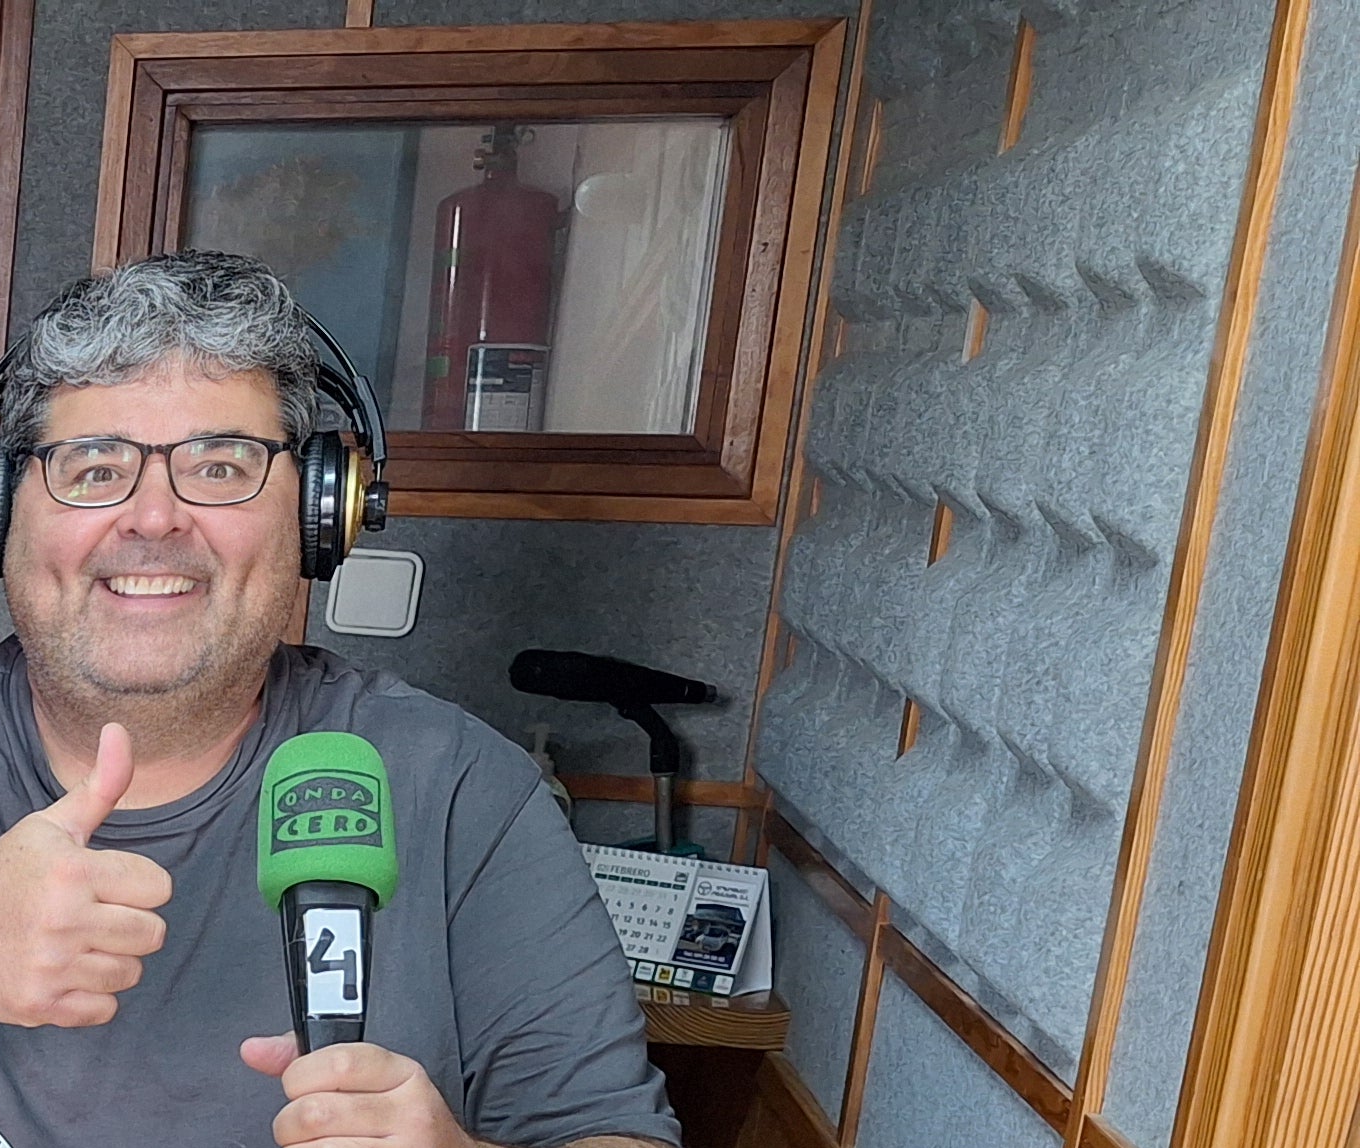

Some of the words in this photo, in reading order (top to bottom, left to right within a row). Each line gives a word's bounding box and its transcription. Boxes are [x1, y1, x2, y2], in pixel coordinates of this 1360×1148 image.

[284, 786, 366, 807] ONDA
[287, 815, 369, 836] CERO
[610, 864, 651, 878] FEBRERO
[307, 928, 359, 1000] 4
